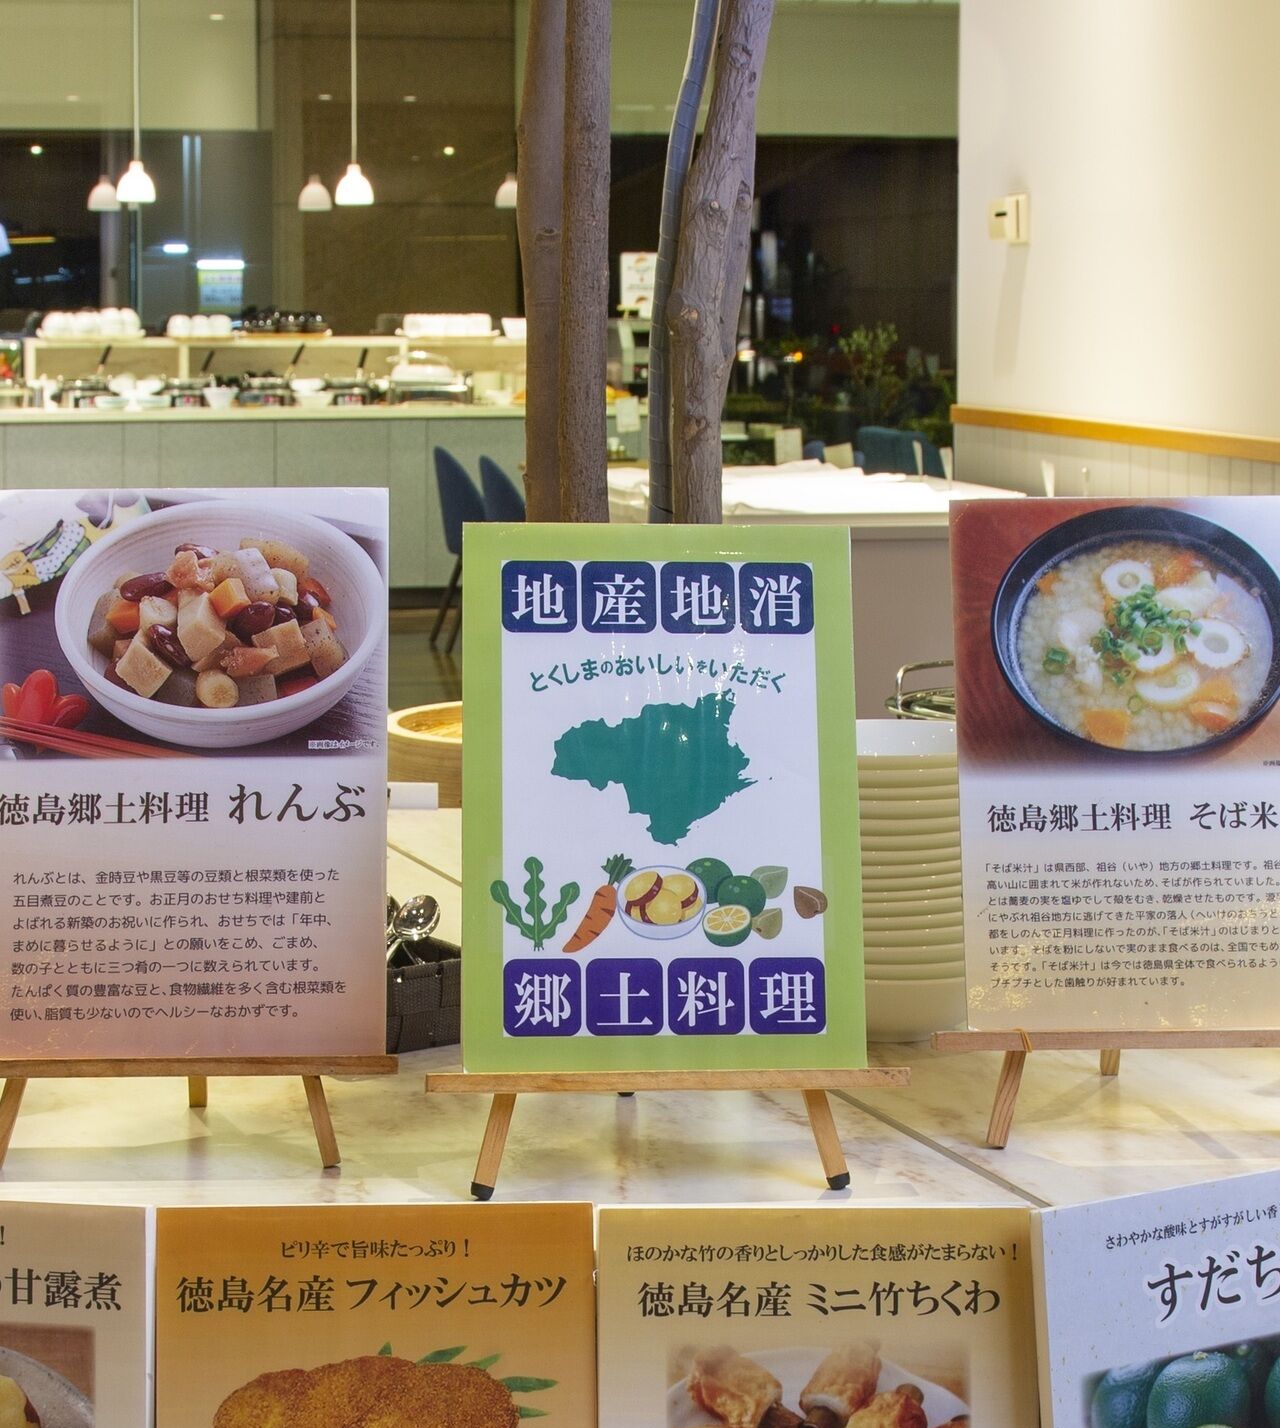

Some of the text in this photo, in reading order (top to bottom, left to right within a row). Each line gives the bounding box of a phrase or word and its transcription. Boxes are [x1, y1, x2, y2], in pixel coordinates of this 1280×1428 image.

[510, 571, 802, 630] 地産地消
[528, 653, 788, 695] とくしまのおいしいをいただく
[228, 781, 366, 824] れんぶ
[986, 802, 1173, 834] 徳島郷土料理
[12, 868, 341, 886] れんぶとは、金時豆や黒豆等の豆類と根菜類を使った
[12, 890, 326, 908] 五目煮豆のことです。お正月のおせち料理や建前と
[12, 913, 333, 931] よばれる新築のお祝いに作られ、おせちでは「年中、
[11, 936, 322, 953] まめに暮らせるように」との願いをこめ、ごまめ、
[11, 959, 321, 976] 数の子とともに三つ肴の一つに数えられています。
[11, 980, 347, 998] たんぱく質の豊富な豆と、食物繊維を多く含む根菜類を
[513, 968, 816, 1030] 郷土料理
[10, 1004, 300, 1022] 使い、脂質も少ないのでヘルシーなおかずです。
[280, 1238, 471, 1261] ピリ辛で旨味たっぷり！
[626, 1243, 1019, 1263] ほのかな竹の香りとしっかりした食感がたまらない！
[176, 1274, 568, 1314] 徳島名産 フィッシュカツ
[638, 1279, 1001, 1319] 徳島名産 ミニ竹ちくわ
